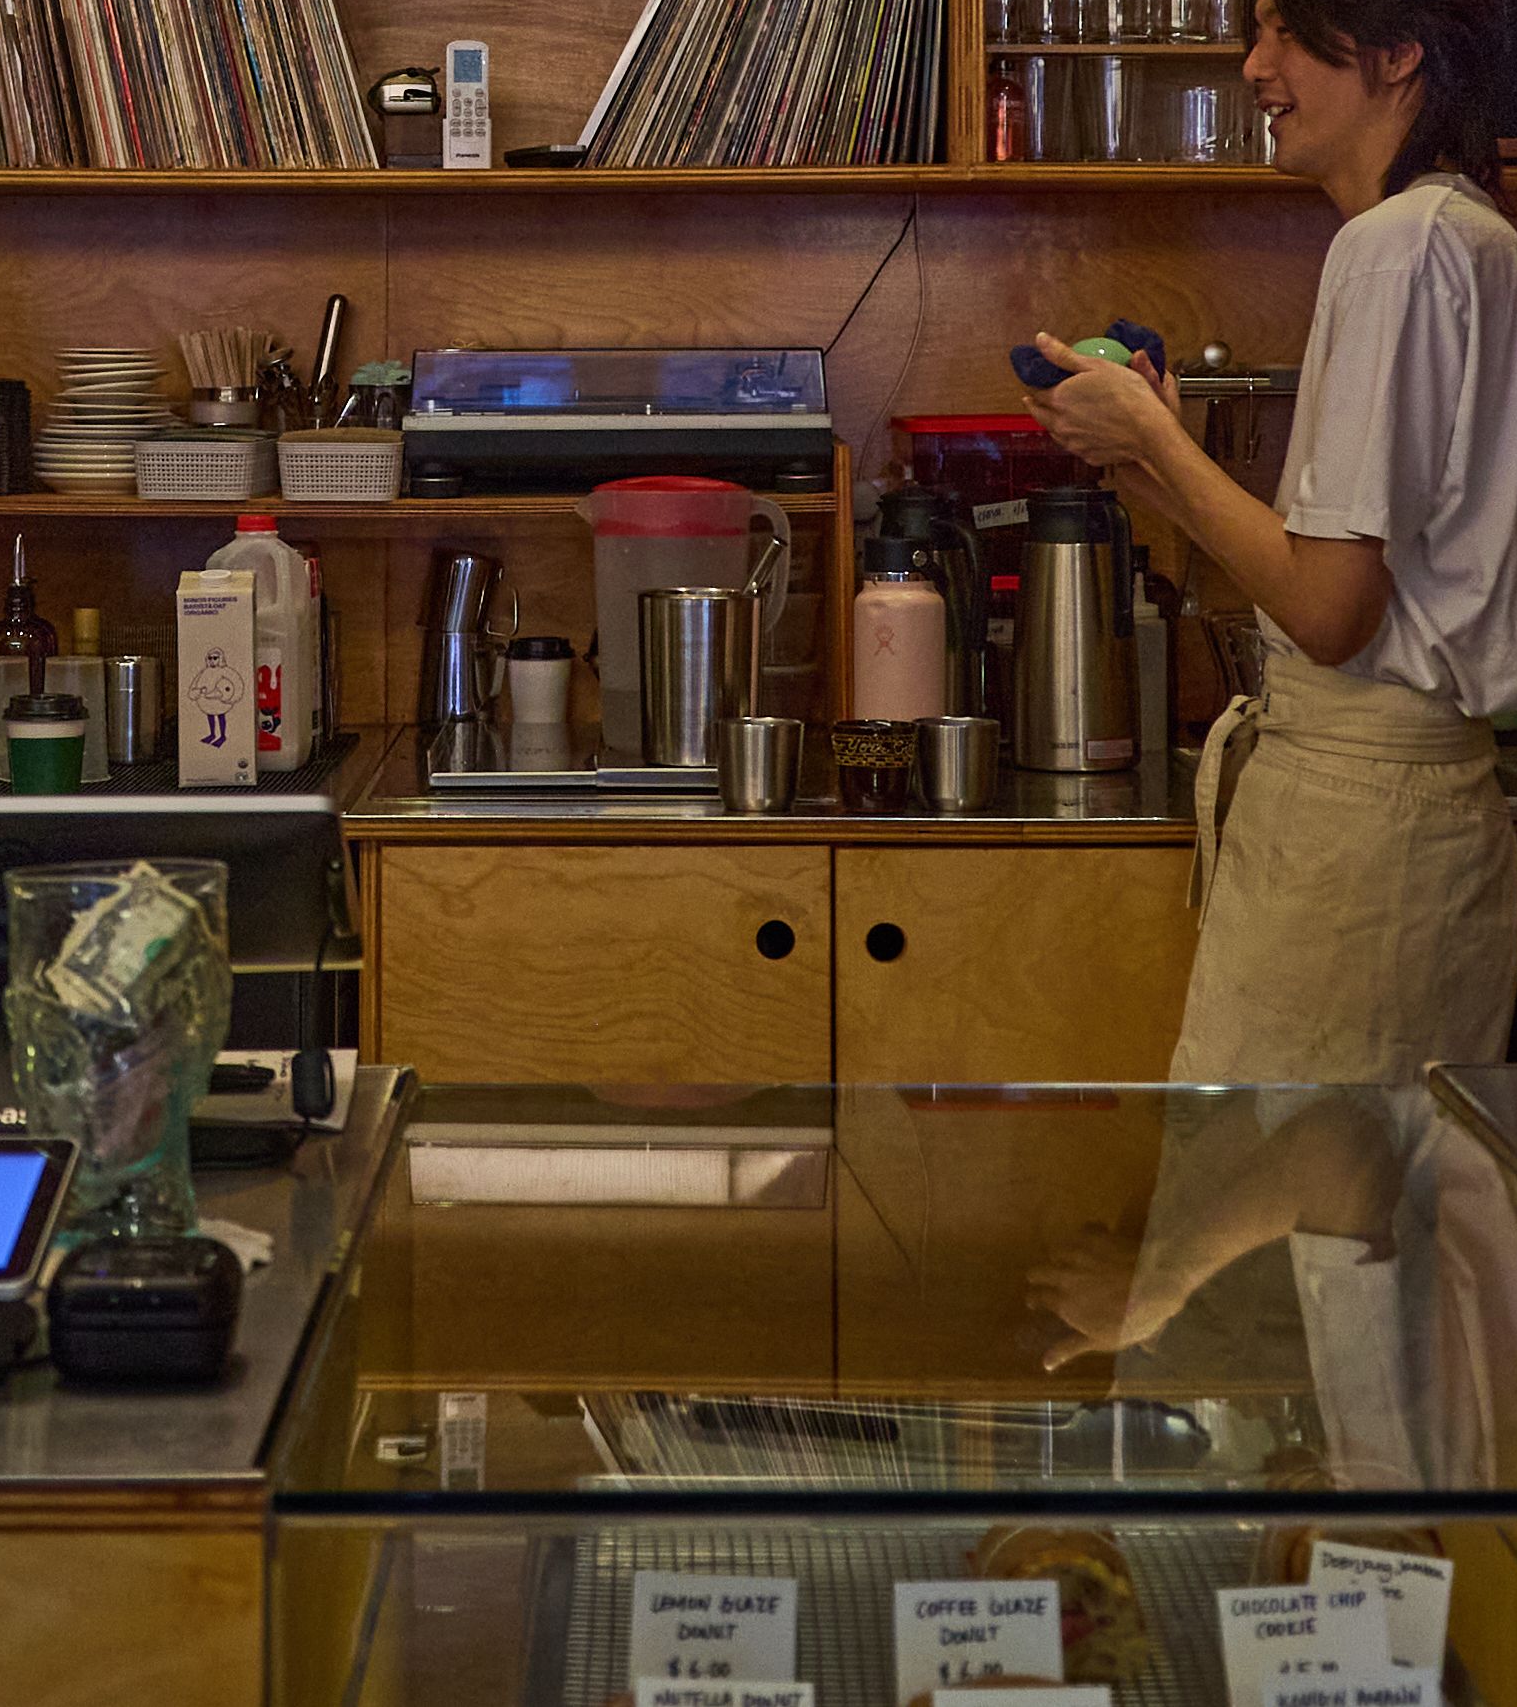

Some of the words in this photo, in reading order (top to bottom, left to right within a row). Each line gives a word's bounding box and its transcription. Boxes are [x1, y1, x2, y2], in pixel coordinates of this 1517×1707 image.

[650, 1595, 712, 1614] LEMON
[720, 1595, 781, 1614] GLAZE
[916, 1598, 978, 1619] COFFEE
[988, 1596, 1047, 1617] GLAZE
[1230, 1595, 1318, 1617] CHOCOLATE
[1328, 1591, 1366, 1609] CHIP
[678, 1623, 738, 1641] DONUT
[940, 1625, 1000, 1646] DONUT
[1255, 1618, 1317, 1640] COOKIE
